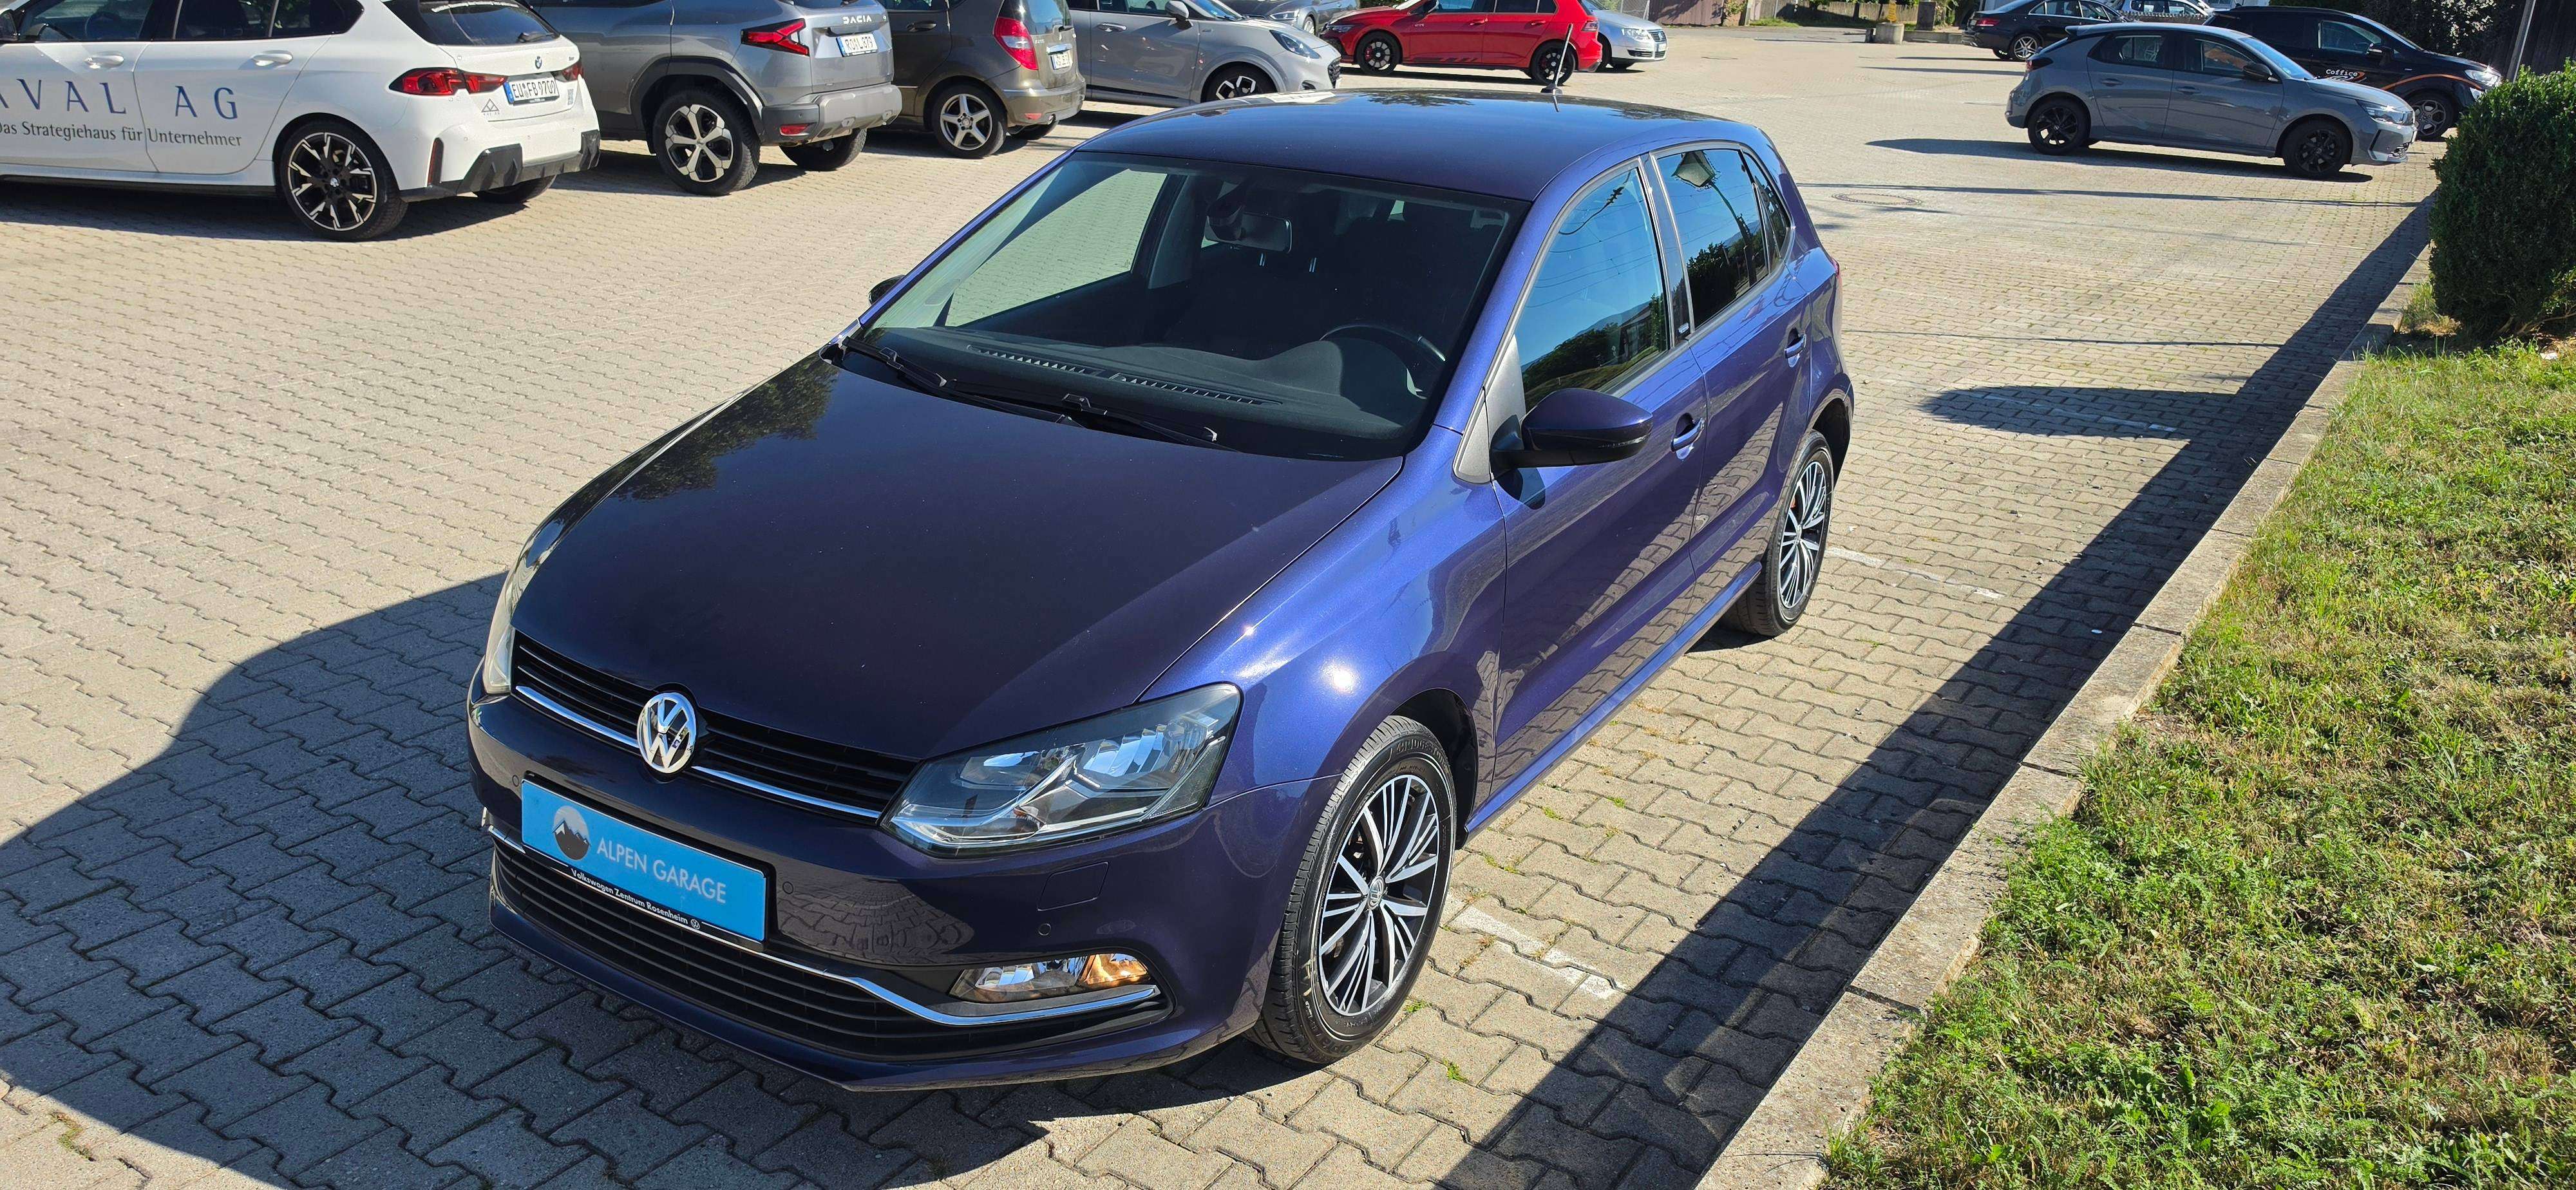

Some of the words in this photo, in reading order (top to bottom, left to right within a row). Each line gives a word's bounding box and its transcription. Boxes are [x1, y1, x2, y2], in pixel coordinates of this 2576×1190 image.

[842, 15, 872, 24] DACIA
[0, 79, 126, 114] VAL
[175, 86, 238, 120] AG
[22, 121, 116, 141] Strategiehaus
[122, 126, 142, 142] für
[147, 128, 242, 147] Unternehmer
[596, 836, 647, 874] ALPEN
[652, 859, 726, 904] GARAGE
[571, 868, 614, 894] Volkswagen
[614, 888, 645, 907] Zentrum
[647, 902, 688, 925] Rosenheim
